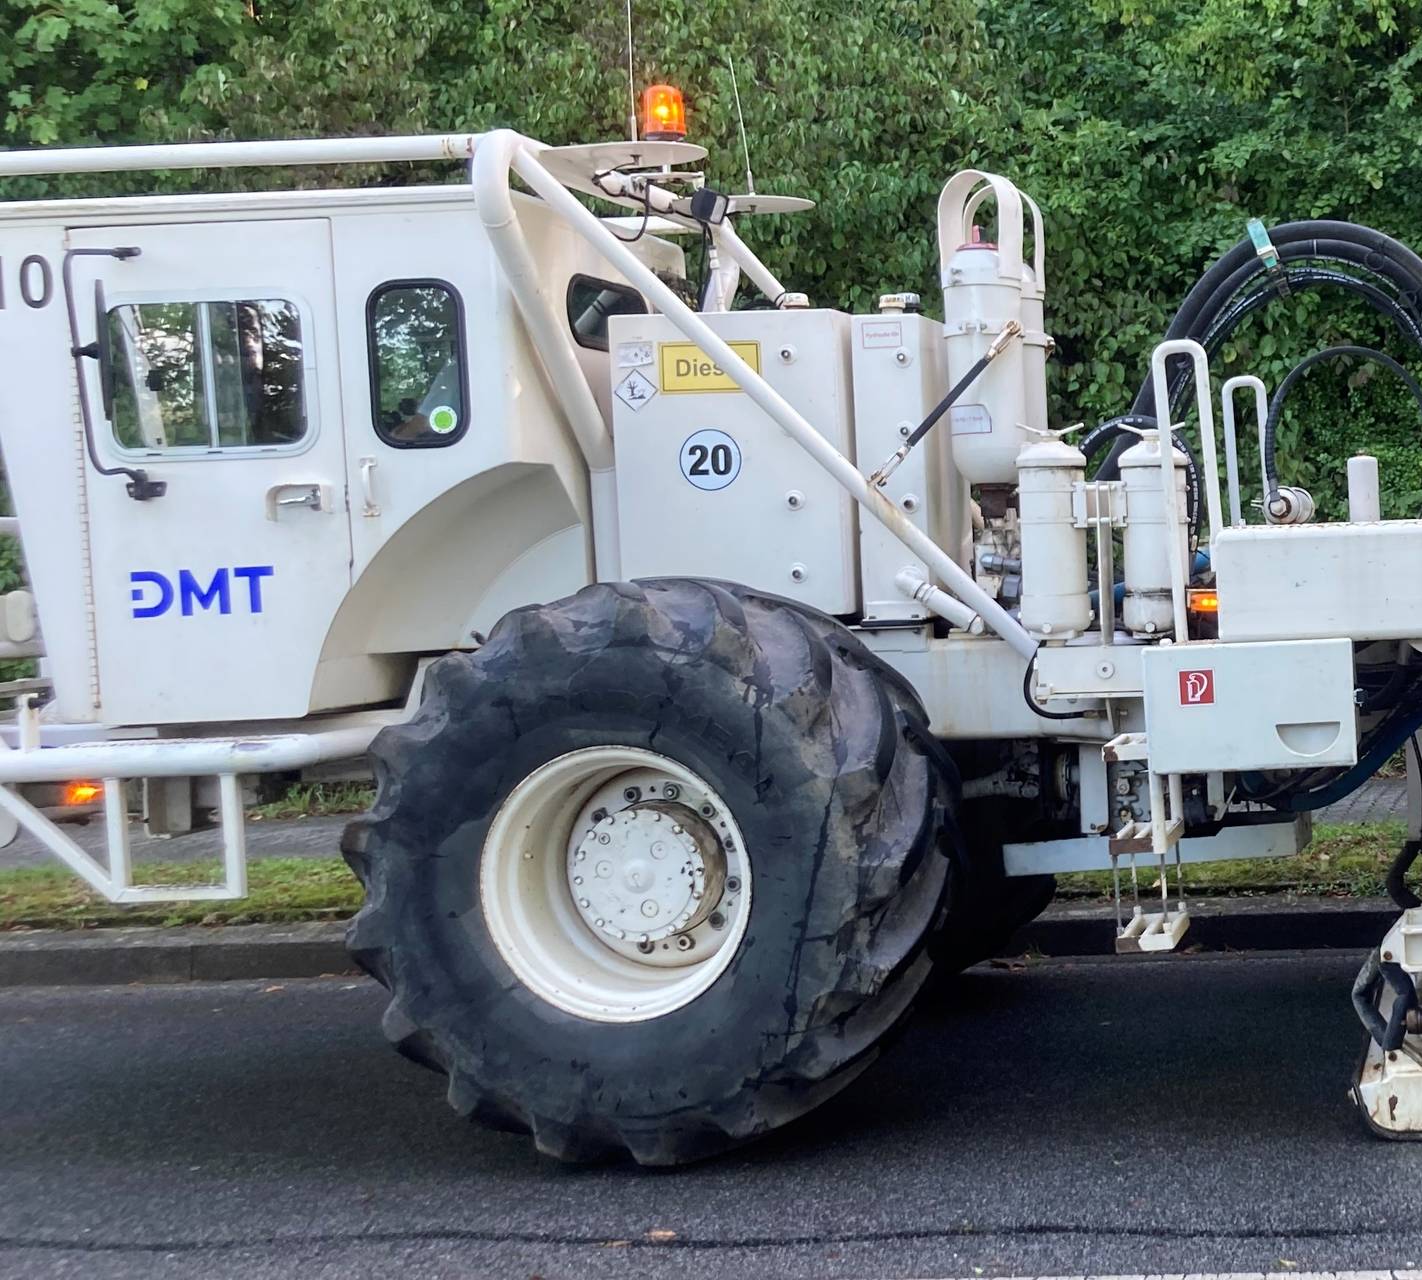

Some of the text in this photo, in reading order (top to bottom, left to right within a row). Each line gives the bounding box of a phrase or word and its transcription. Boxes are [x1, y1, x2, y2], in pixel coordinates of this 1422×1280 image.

[676, 357, 746, 378] Dies
[688, 444, 733, 476] 20
[130, 565, 275, 619] DMT
